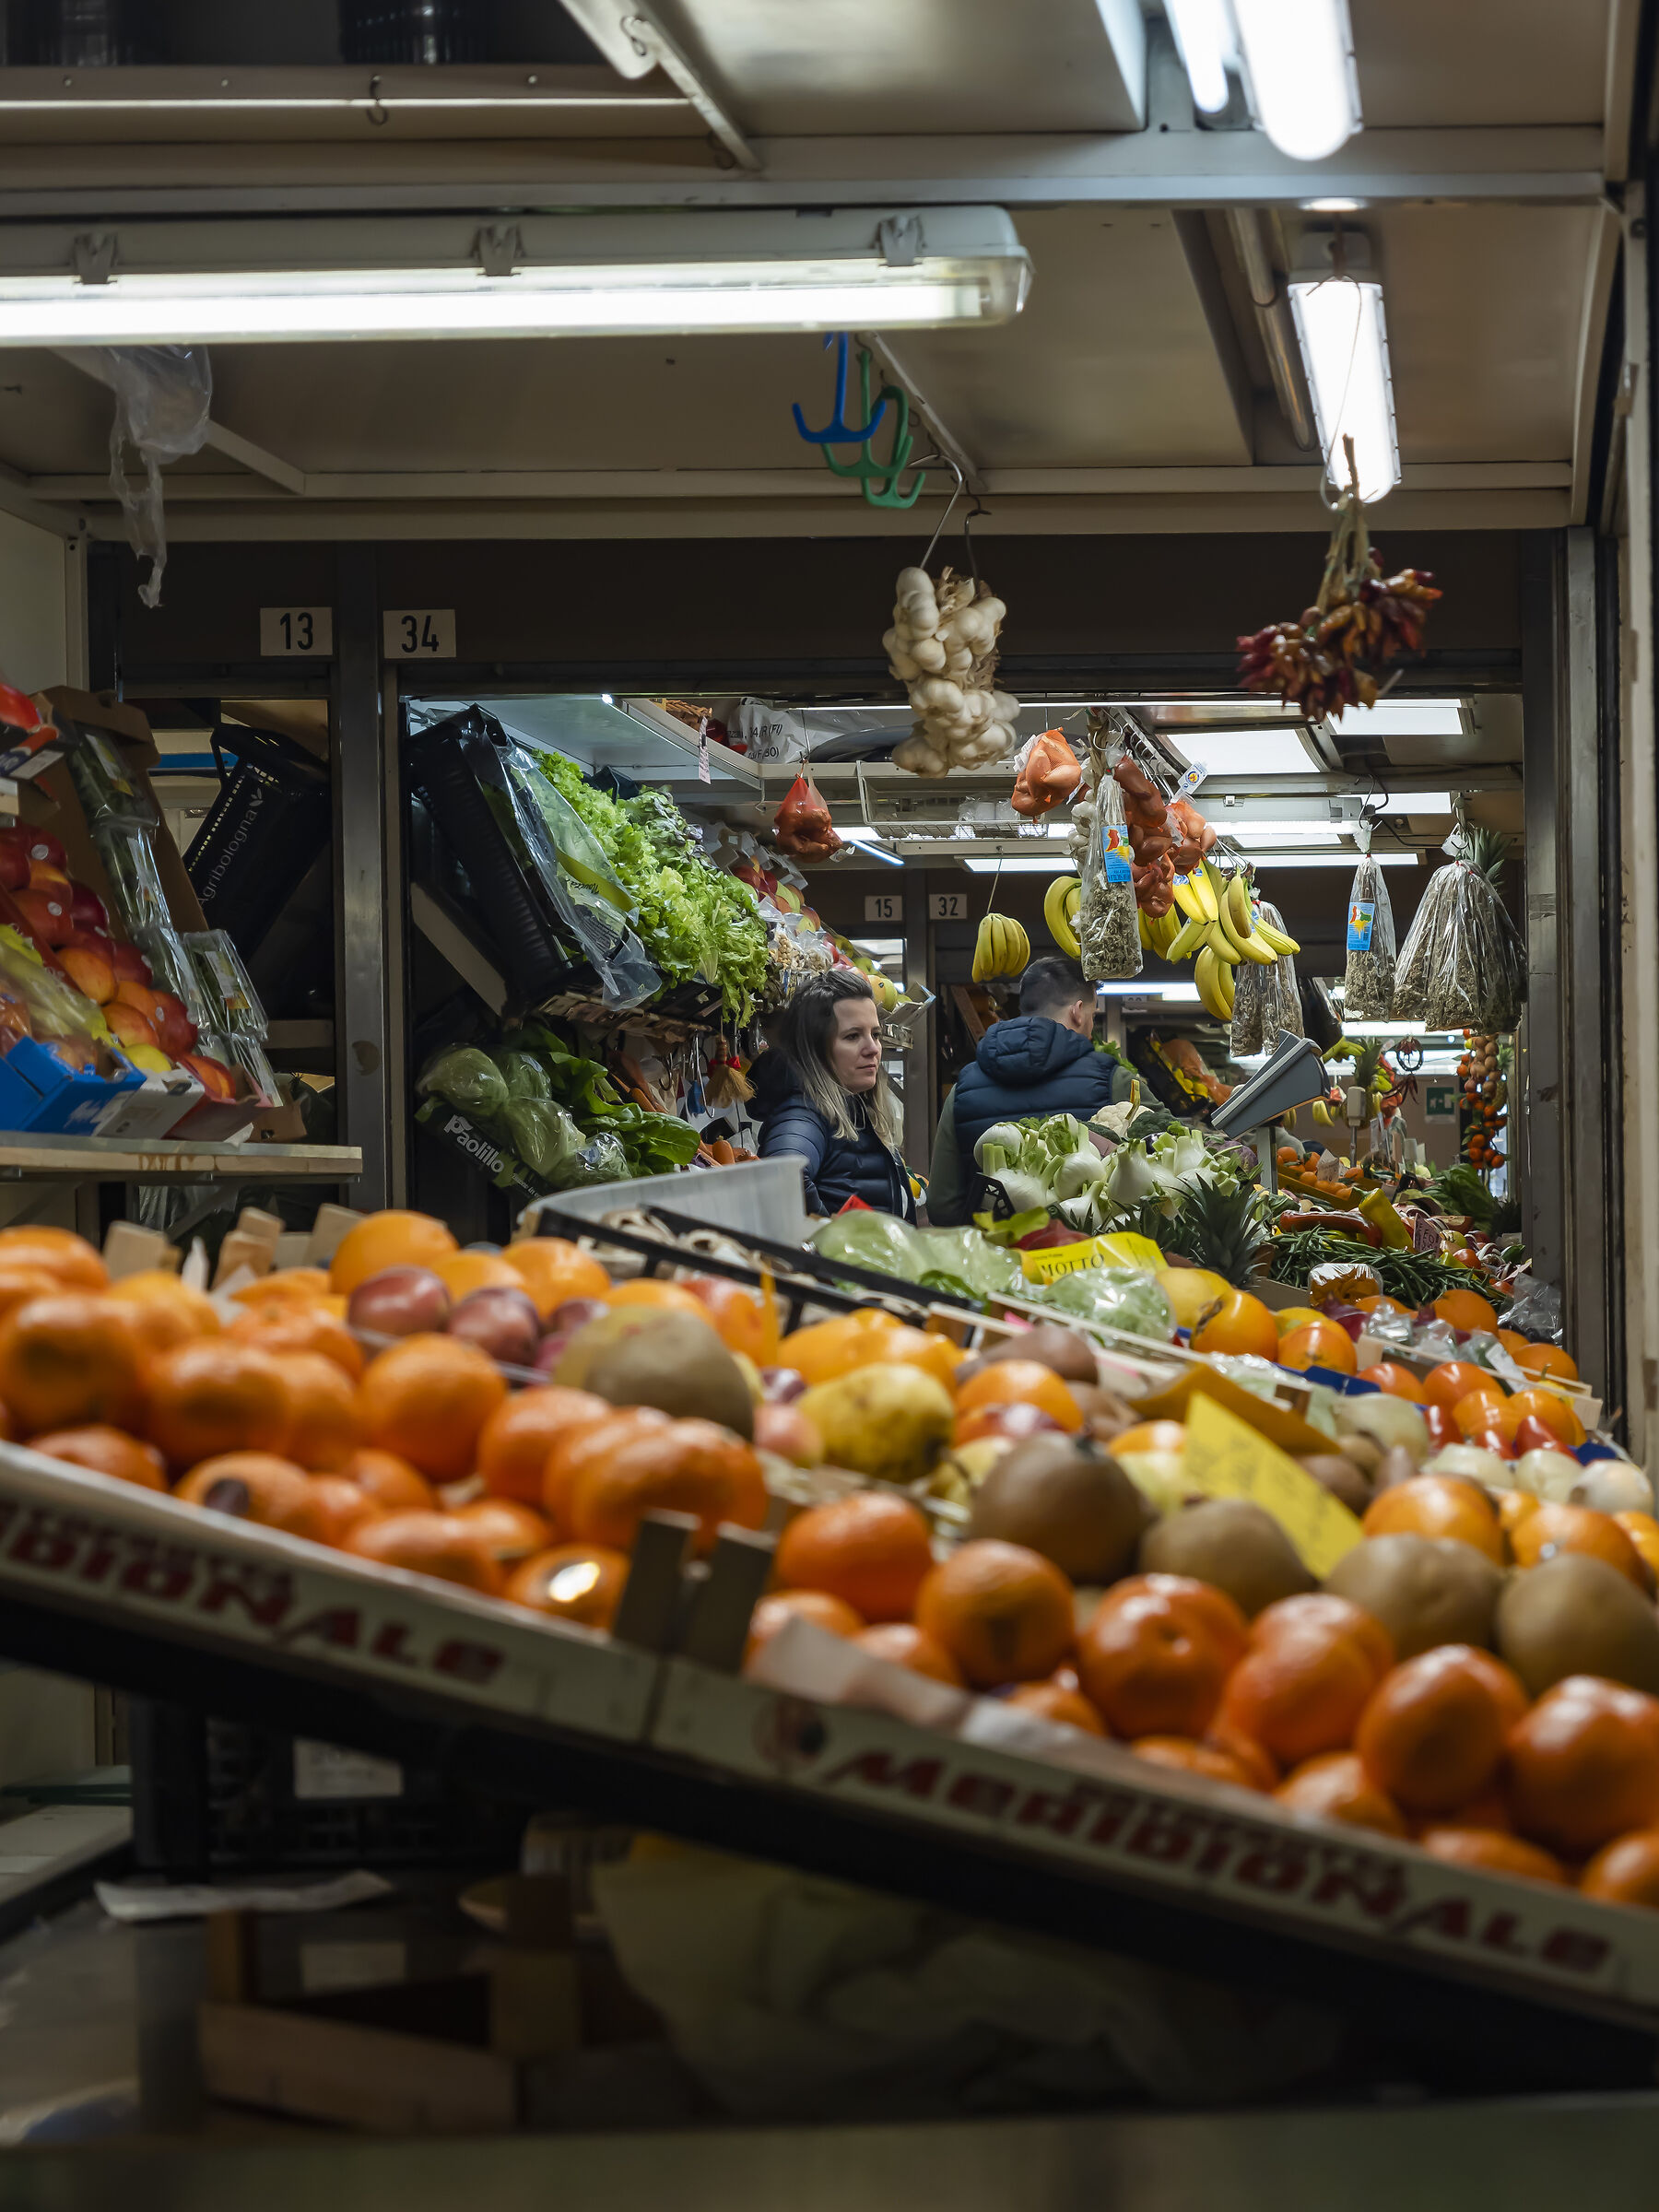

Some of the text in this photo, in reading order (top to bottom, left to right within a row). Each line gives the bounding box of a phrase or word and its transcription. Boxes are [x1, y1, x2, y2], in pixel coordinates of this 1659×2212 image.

[279, 612, 313, 650] 13
[401, 615, 440, 653] 34
[197, 809, 259, 908] Agribologna
[875, 898, 893, 918] 15
[938, 896, 959, 917] 32
[443, 1114, 504, 1173] Paolillo
